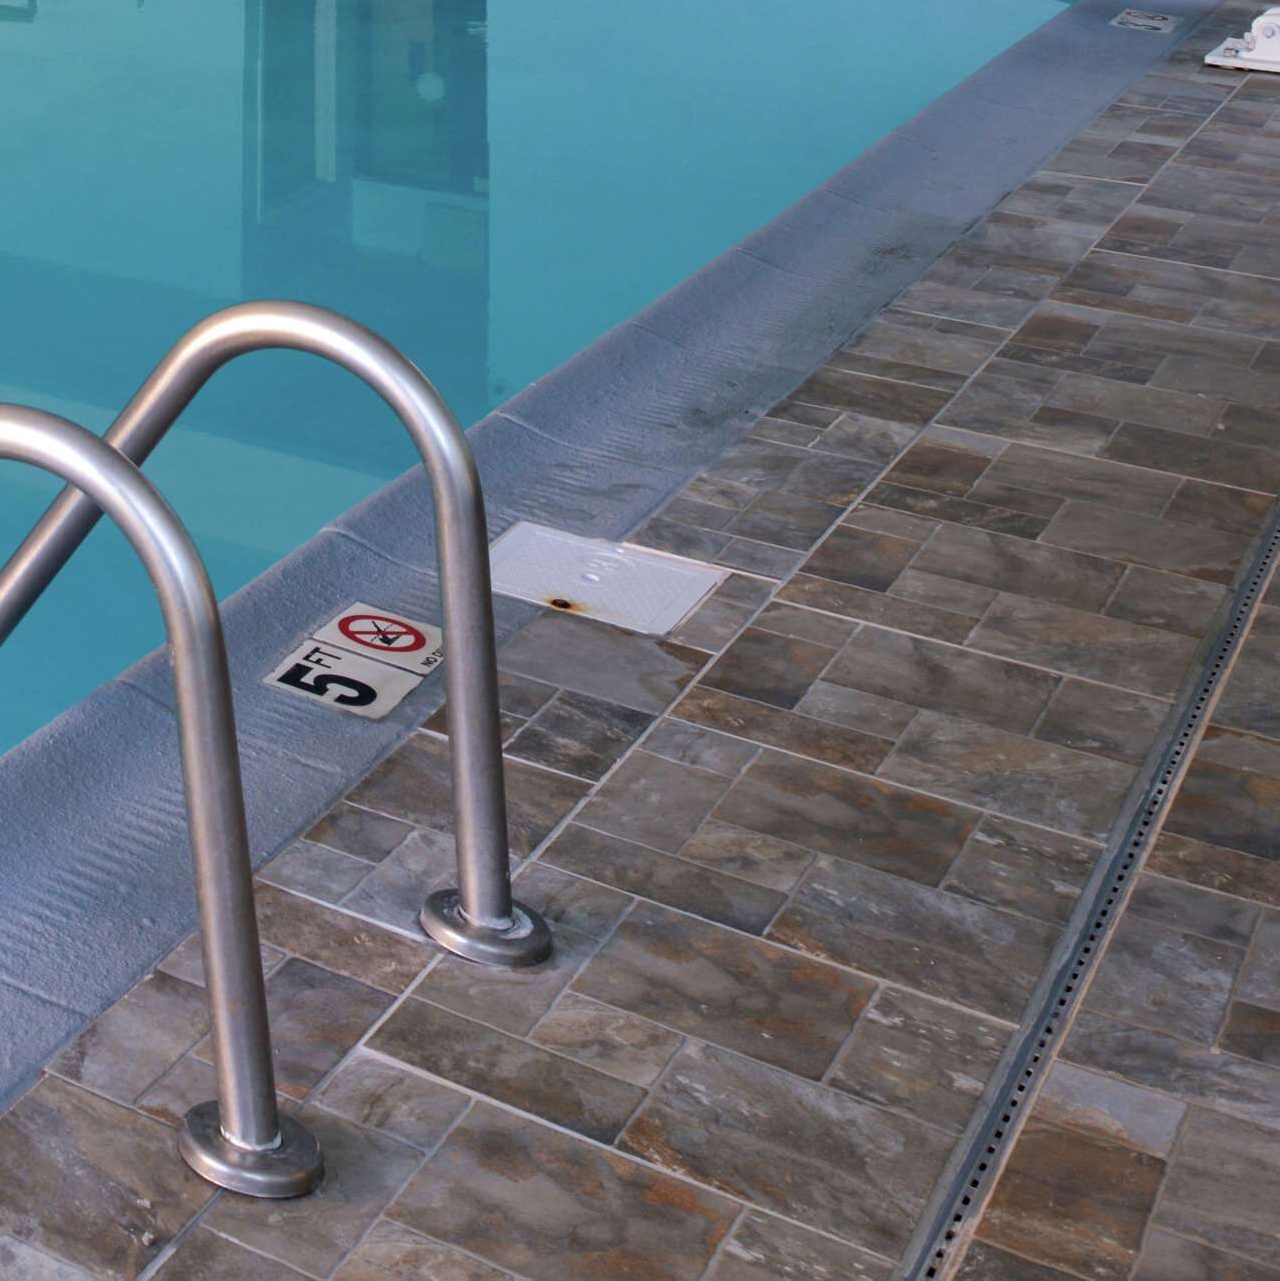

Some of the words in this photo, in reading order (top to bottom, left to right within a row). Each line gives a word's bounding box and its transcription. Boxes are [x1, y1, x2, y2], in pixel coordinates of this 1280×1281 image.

[302, 646, 342, 669] FT
[420, 657, 438, 668] NO
[277, 662, 378, 707] 5
